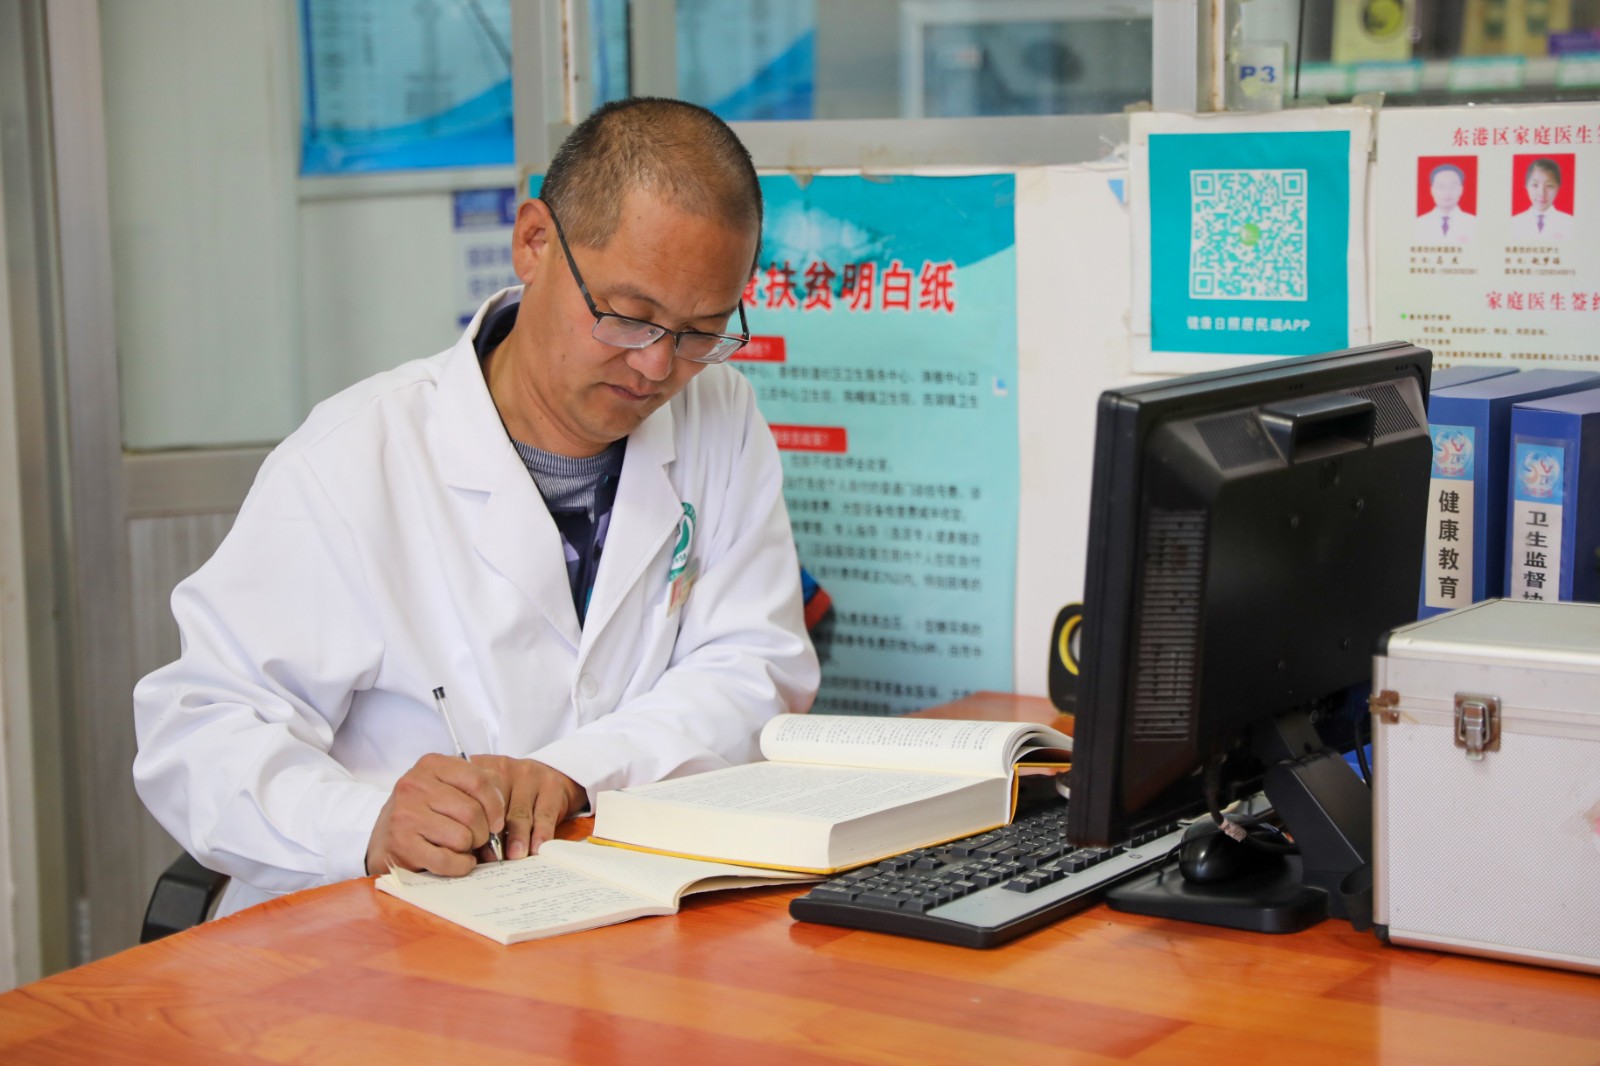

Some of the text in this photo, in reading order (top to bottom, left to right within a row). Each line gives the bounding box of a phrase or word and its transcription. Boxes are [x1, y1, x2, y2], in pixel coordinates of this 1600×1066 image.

[1452, 124, 1600, 147] 东港区家庭医生
[1438, 490, 1460, 599] 健康教育
